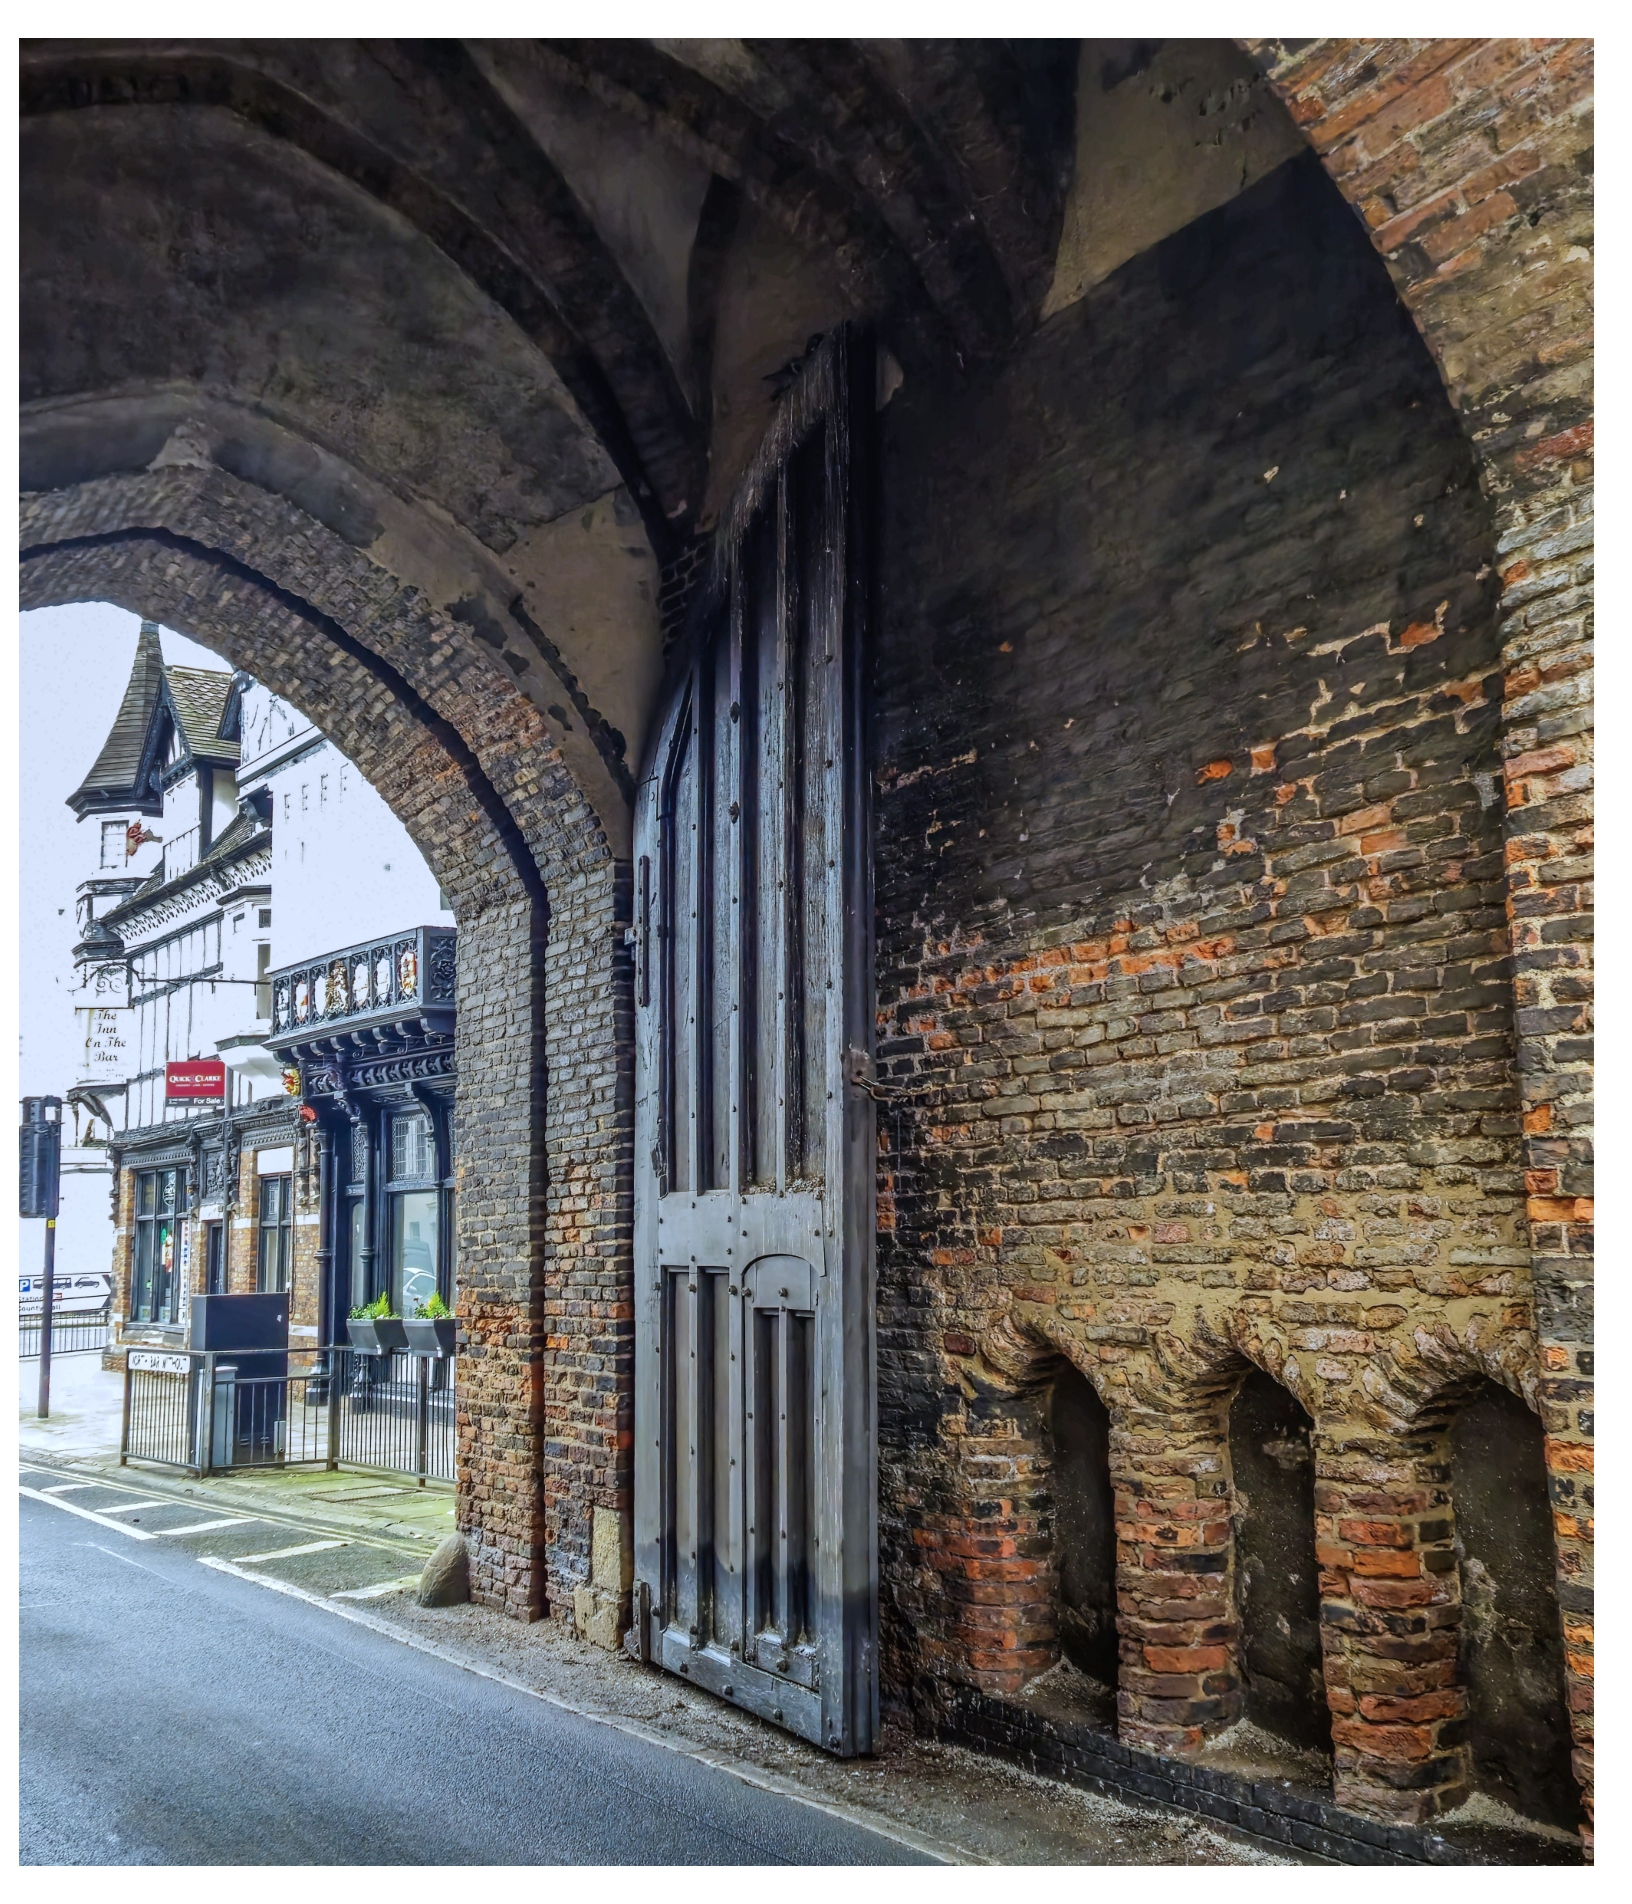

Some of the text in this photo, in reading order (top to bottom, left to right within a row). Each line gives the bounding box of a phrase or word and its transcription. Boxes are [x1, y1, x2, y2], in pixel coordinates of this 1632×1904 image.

[94, 1009, 117, 1020] The
[96, 1023, 117, 1034] Inn
[85, 1036, 127, 1048] On The
[93, 1051, 119, 1062] Bar
